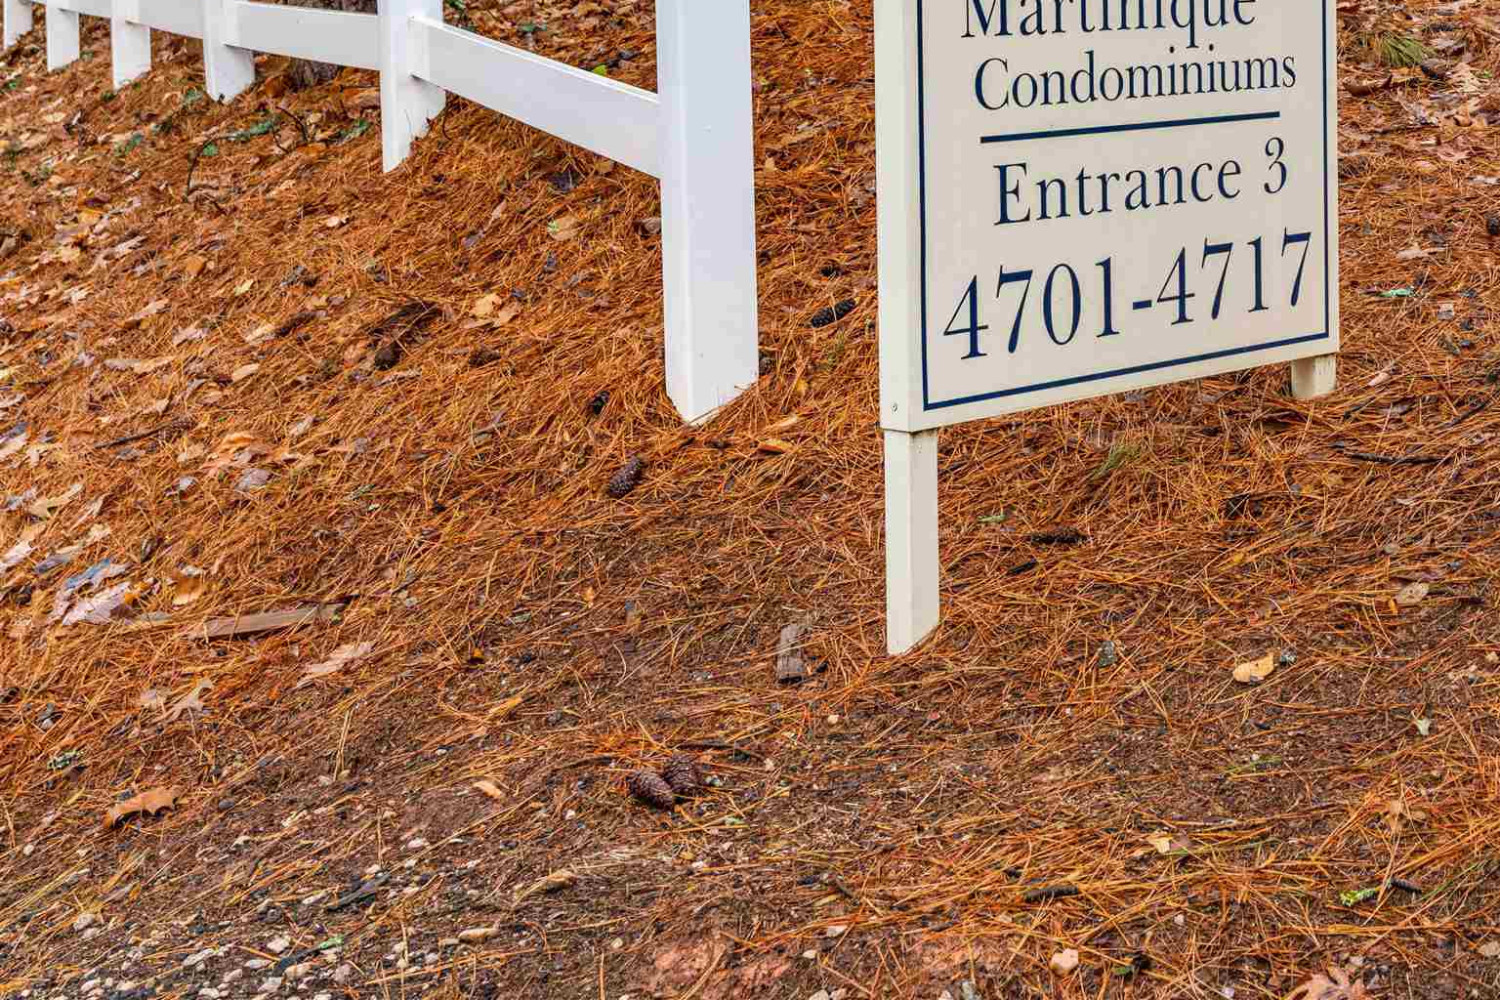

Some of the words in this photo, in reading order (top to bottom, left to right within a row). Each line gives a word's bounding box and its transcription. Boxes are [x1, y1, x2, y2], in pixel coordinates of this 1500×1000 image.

[974, 43, 1297, 111] Condominiums
[992, 159, 1242, 226] Entrance
[1263, 136, 1287, 194] 3
[943, 226, 1312, 360] 4701-4717
